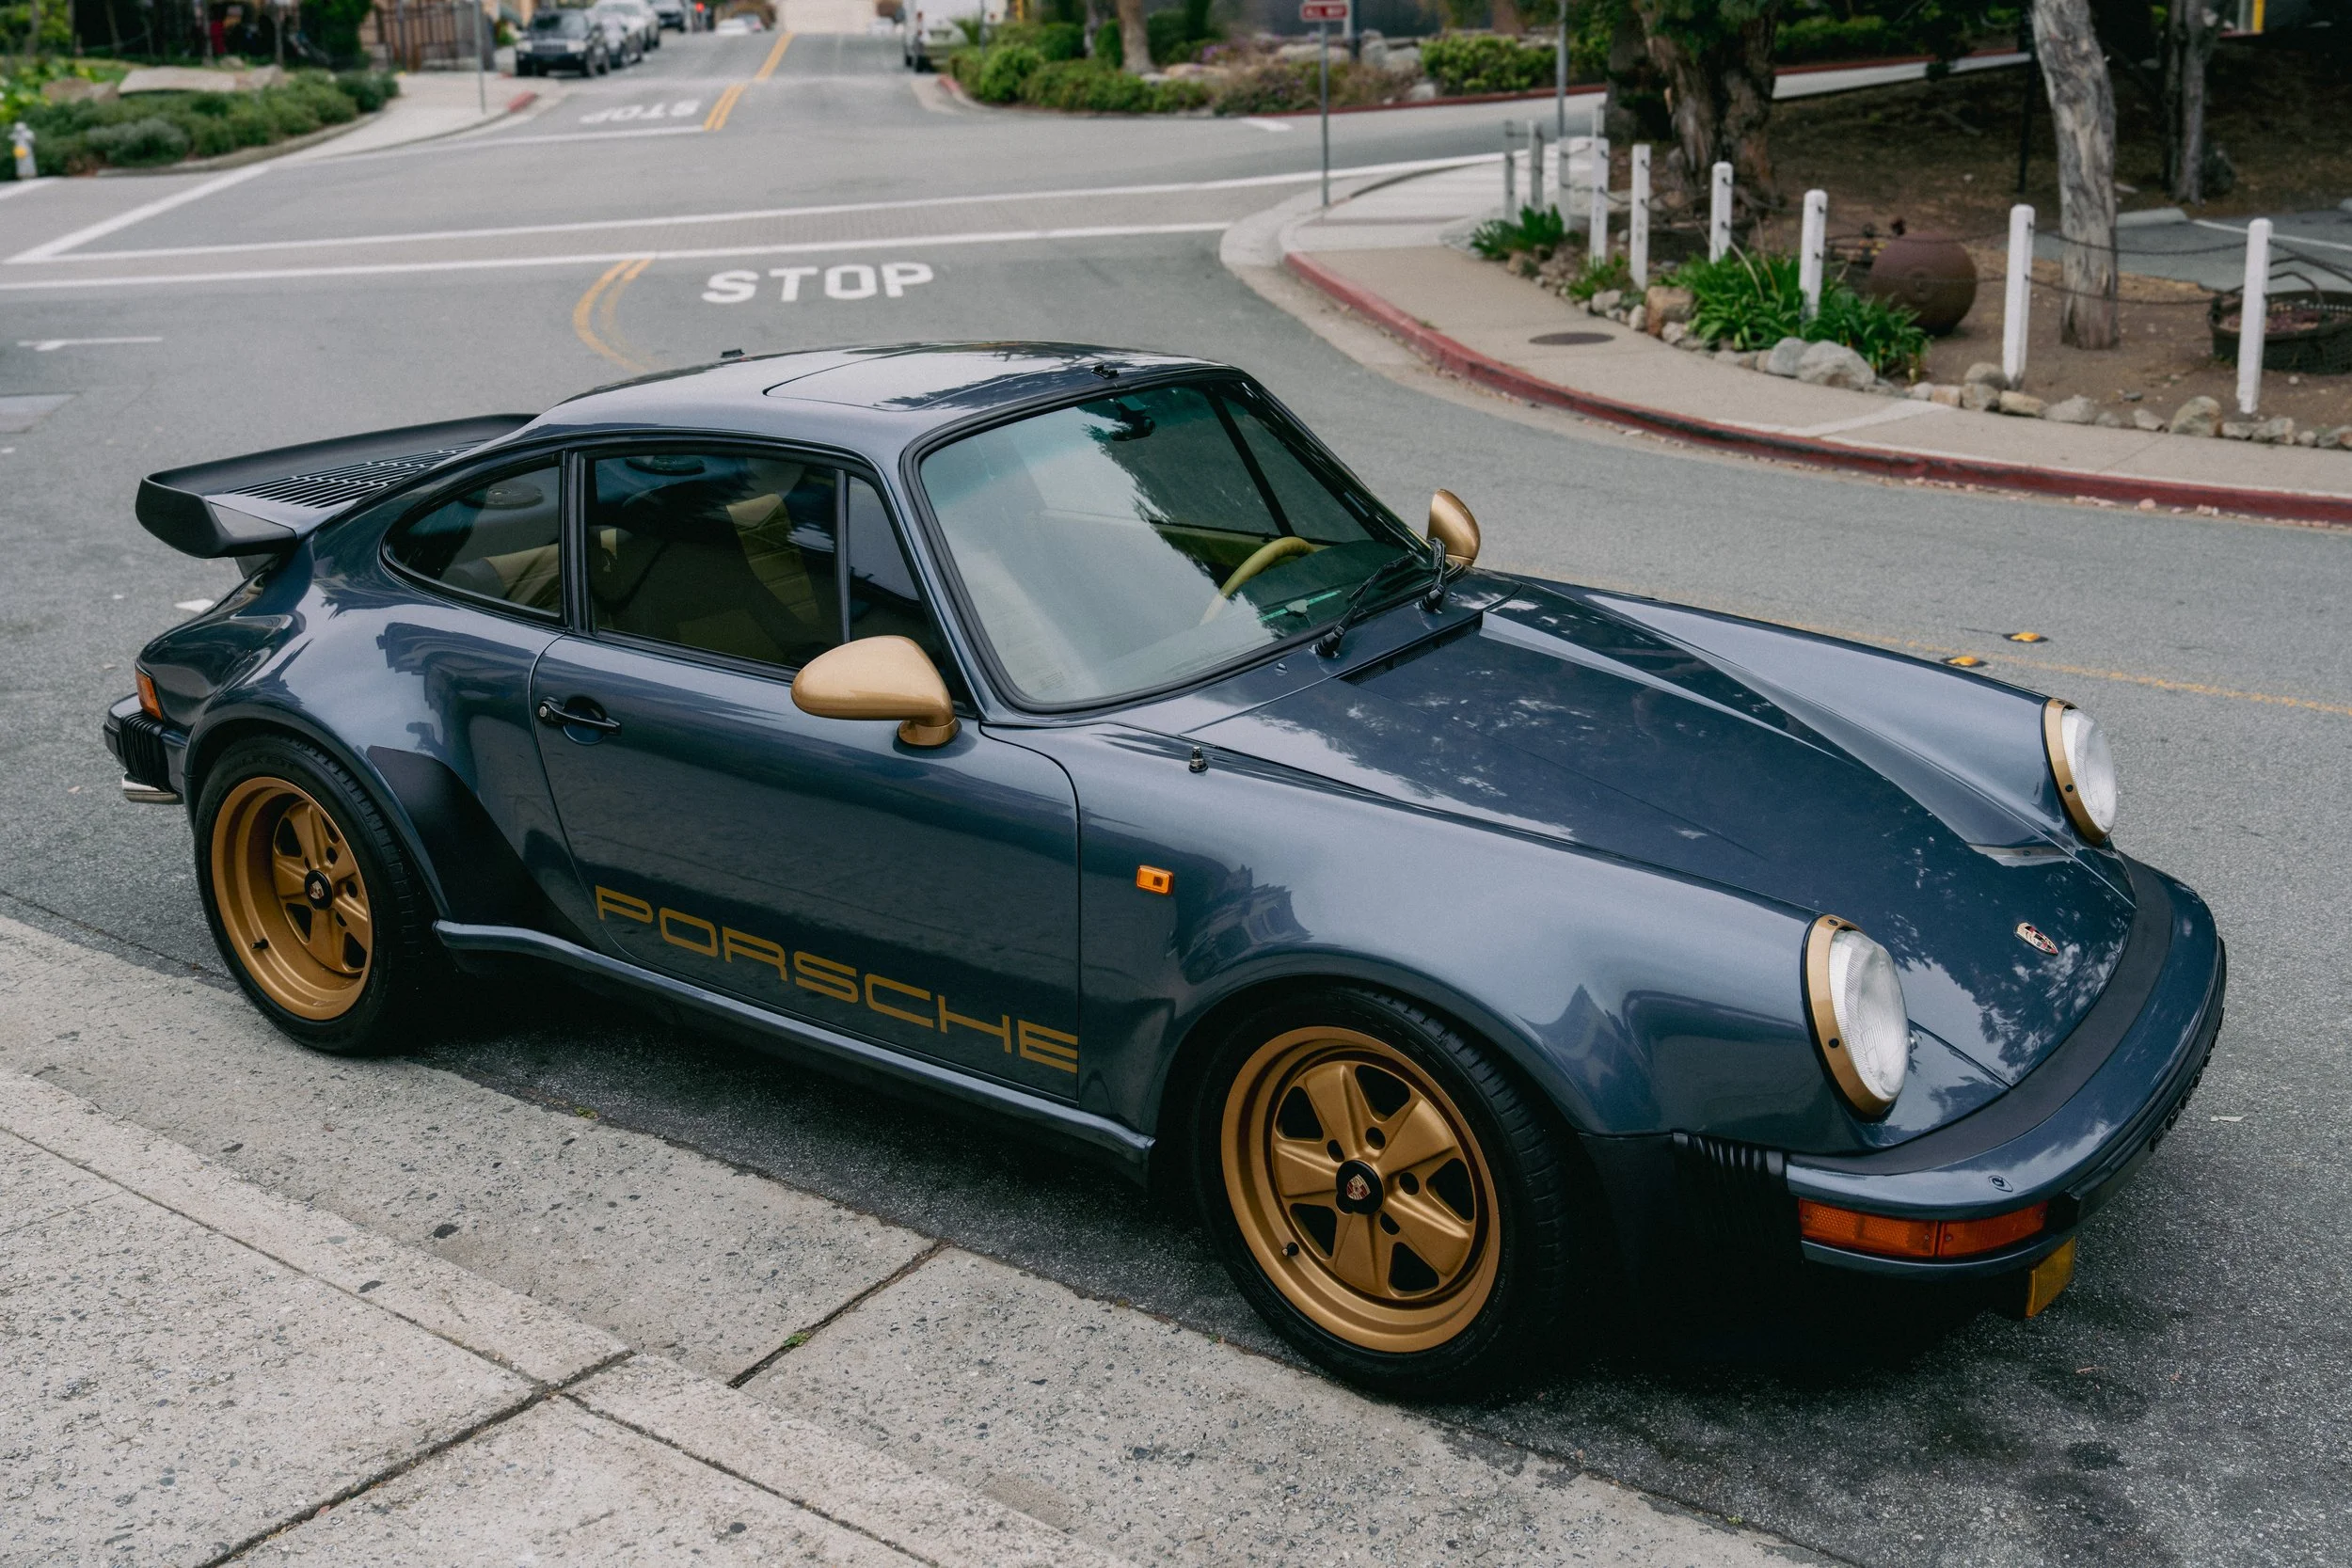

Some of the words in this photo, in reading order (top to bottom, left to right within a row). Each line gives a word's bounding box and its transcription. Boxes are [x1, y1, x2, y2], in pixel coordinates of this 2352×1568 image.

[579, 99, 700, 124] STOP
[701, 261, 934, 304] STOP
[596, 884, 1078, 1073] PORSCHE
